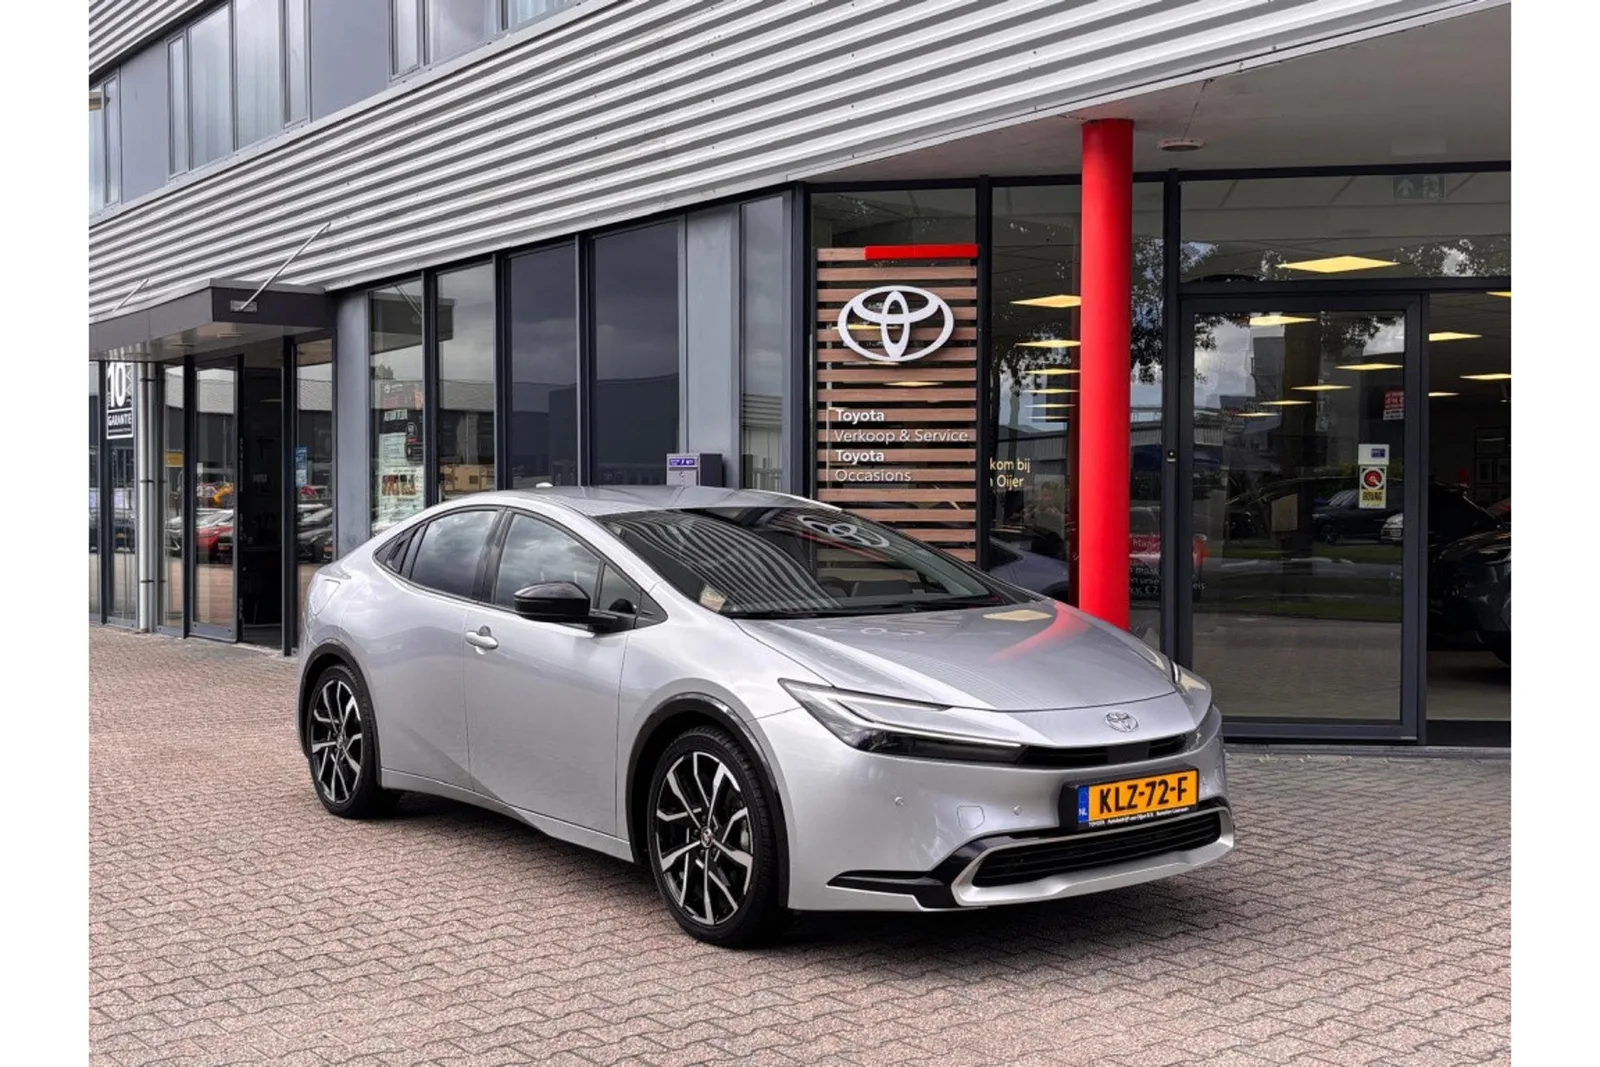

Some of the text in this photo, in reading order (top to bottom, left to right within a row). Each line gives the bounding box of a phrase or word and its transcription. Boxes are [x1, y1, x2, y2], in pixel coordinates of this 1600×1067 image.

[835, 409, 885, 425] Toyota
[834, 429, 969, 445] Verkoop & Service
[835, 449, 885, 465] Toyota
[989, 456, 1031, 474] kom bij
[834, 468, 912, 482] Occasions
[1099, 776, 1188, 815] KLZ-72-F
[1078, 807, 1088, 816] NL
